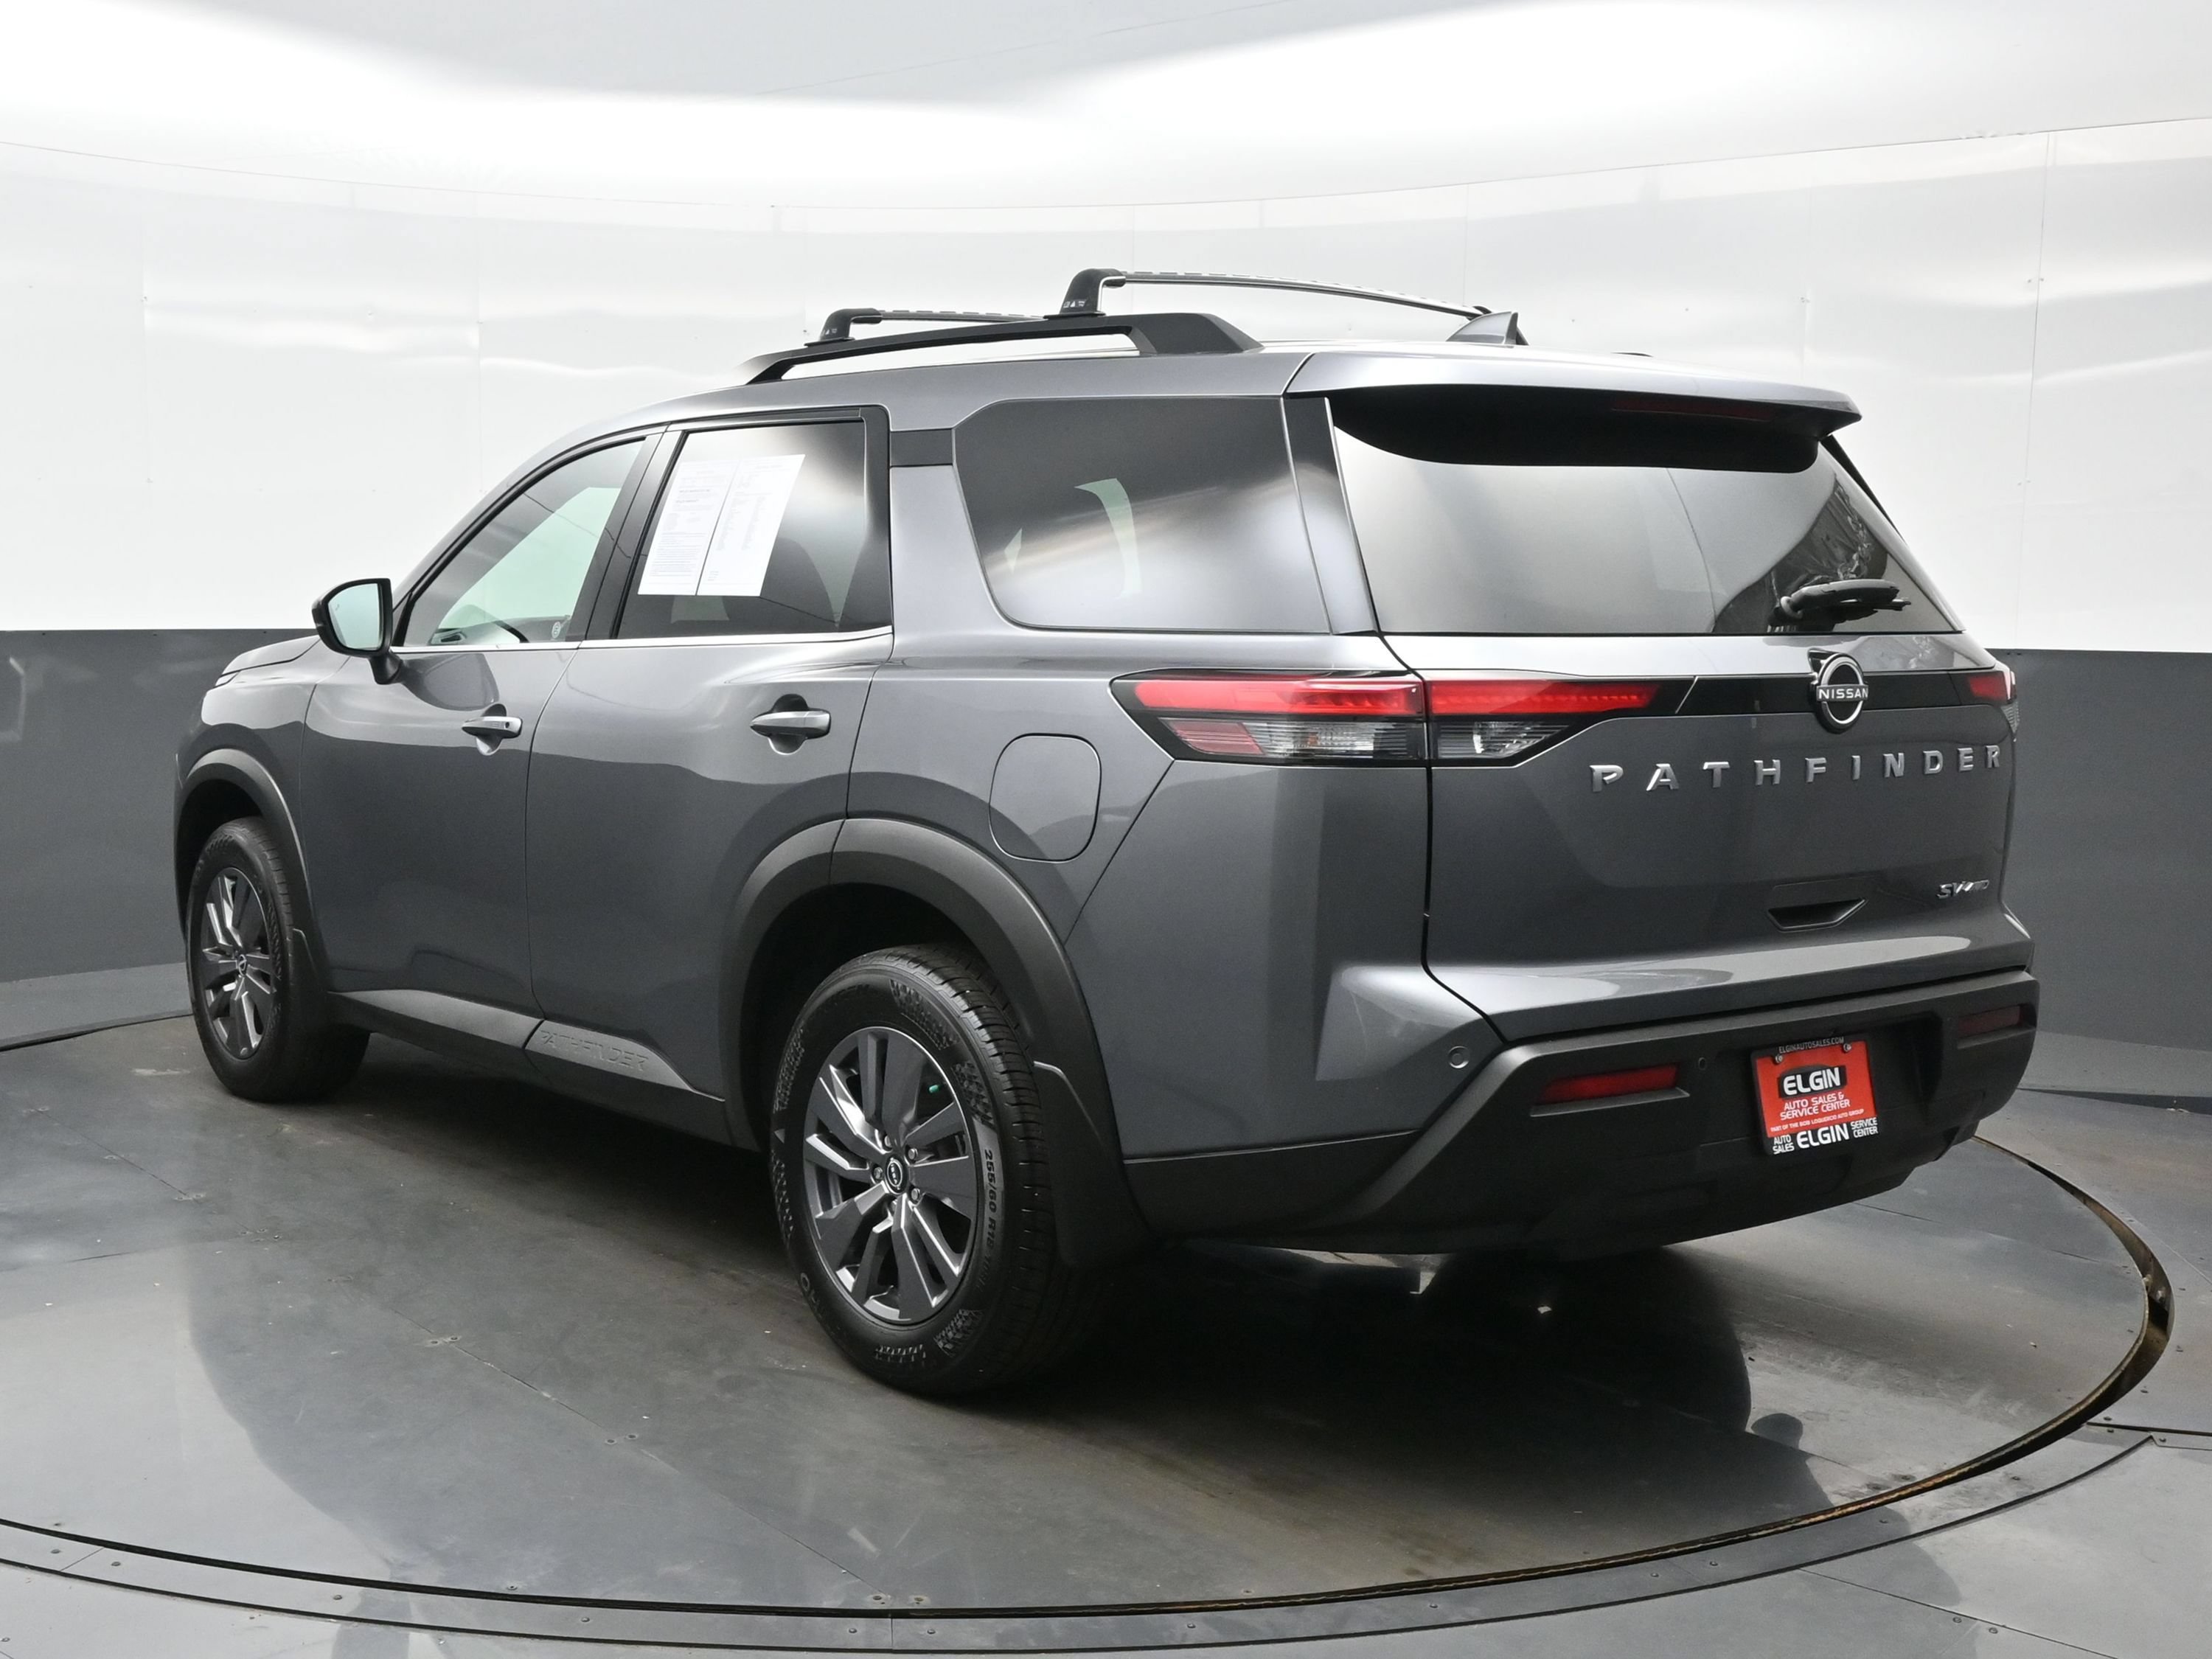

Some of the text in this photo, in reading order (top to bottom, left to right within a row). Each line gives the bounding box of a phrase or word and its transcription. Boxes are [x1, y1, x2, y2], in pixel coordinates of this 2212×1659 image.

[1818, 686, 1869, 703] NISSAN
[1589, 744, 2003, 793] PATHFINDER
[1935, 881, 1964, 900] SV
[1778, 1036, 1845, 1054] ELGINAUTOSALES.COM
[1783, 1067, 1841, 1096] ELGIN
[1779, 1099, 1851, 1121] SERVICE CENTER
[1784, 1091, 1845, 1110] AUTO SALES &
[1851, 1117, 1878, 1130] SERVICE
[1853, 1125, 1879, 1138] CENTER
[1773, 1134, 1792, 1145] AUTO
[1796, 1123, 1849, 1149] ELGIN
[1773, 1142, 1795, 1155] SALES
[984, 1149, 998, 1213] 255/60
